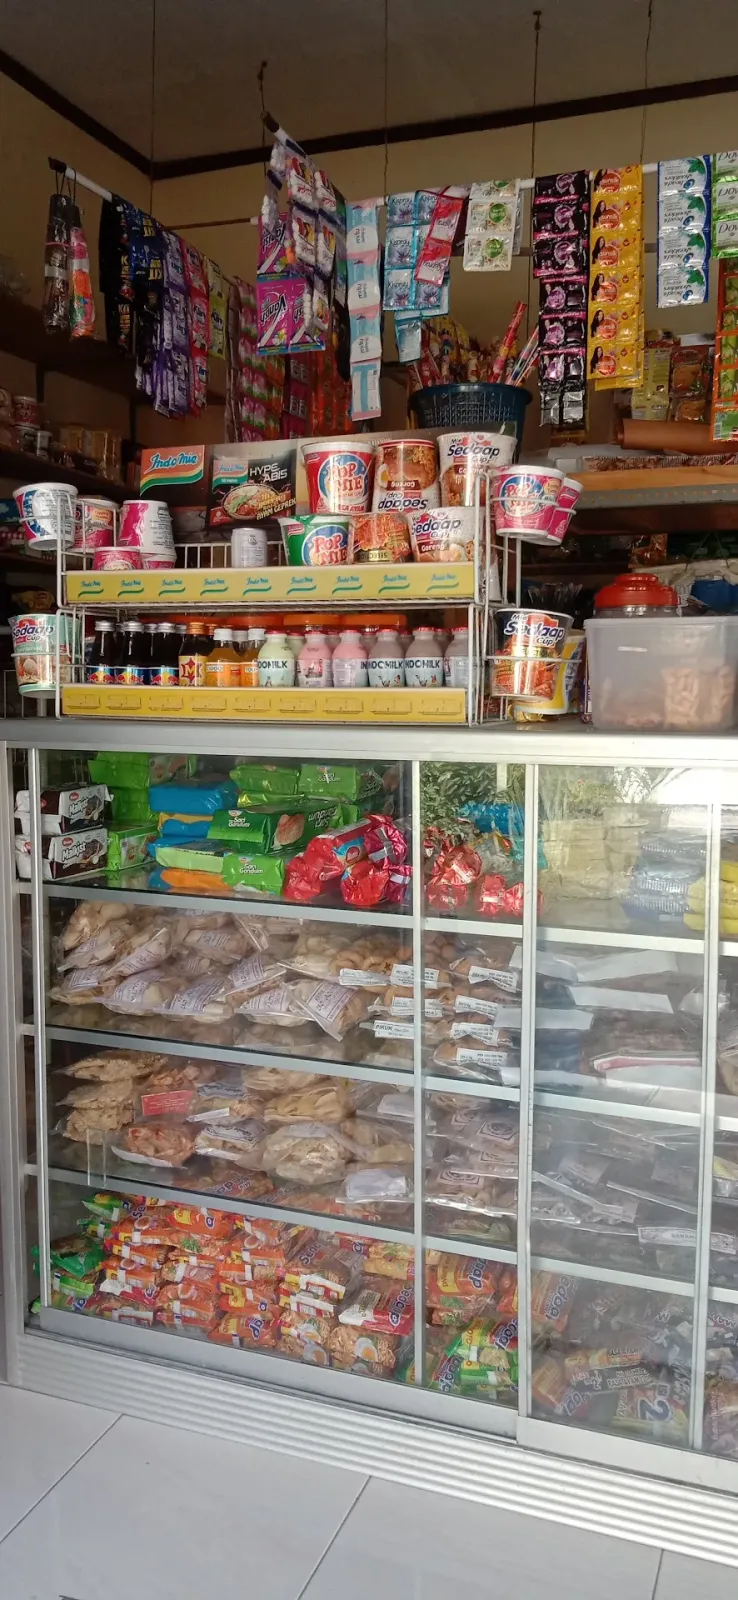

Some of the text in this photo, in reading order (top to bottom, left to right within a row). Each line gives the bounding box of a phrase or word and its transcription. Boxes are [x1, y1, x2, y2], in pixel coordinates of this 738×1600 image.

[447, 443, 500, 459] Sedaap
[250, 463, 280, 477] HYPE
[262, 469, 288, 483] ABIS
[378, 498, 428, 510] Sedaap
[411, 518, 462, 535] Sedaap
[313, 534, 343, 553] POP
[421, 544, 445, 552] Goreng
[62, 840, 86, 862] Malkist
